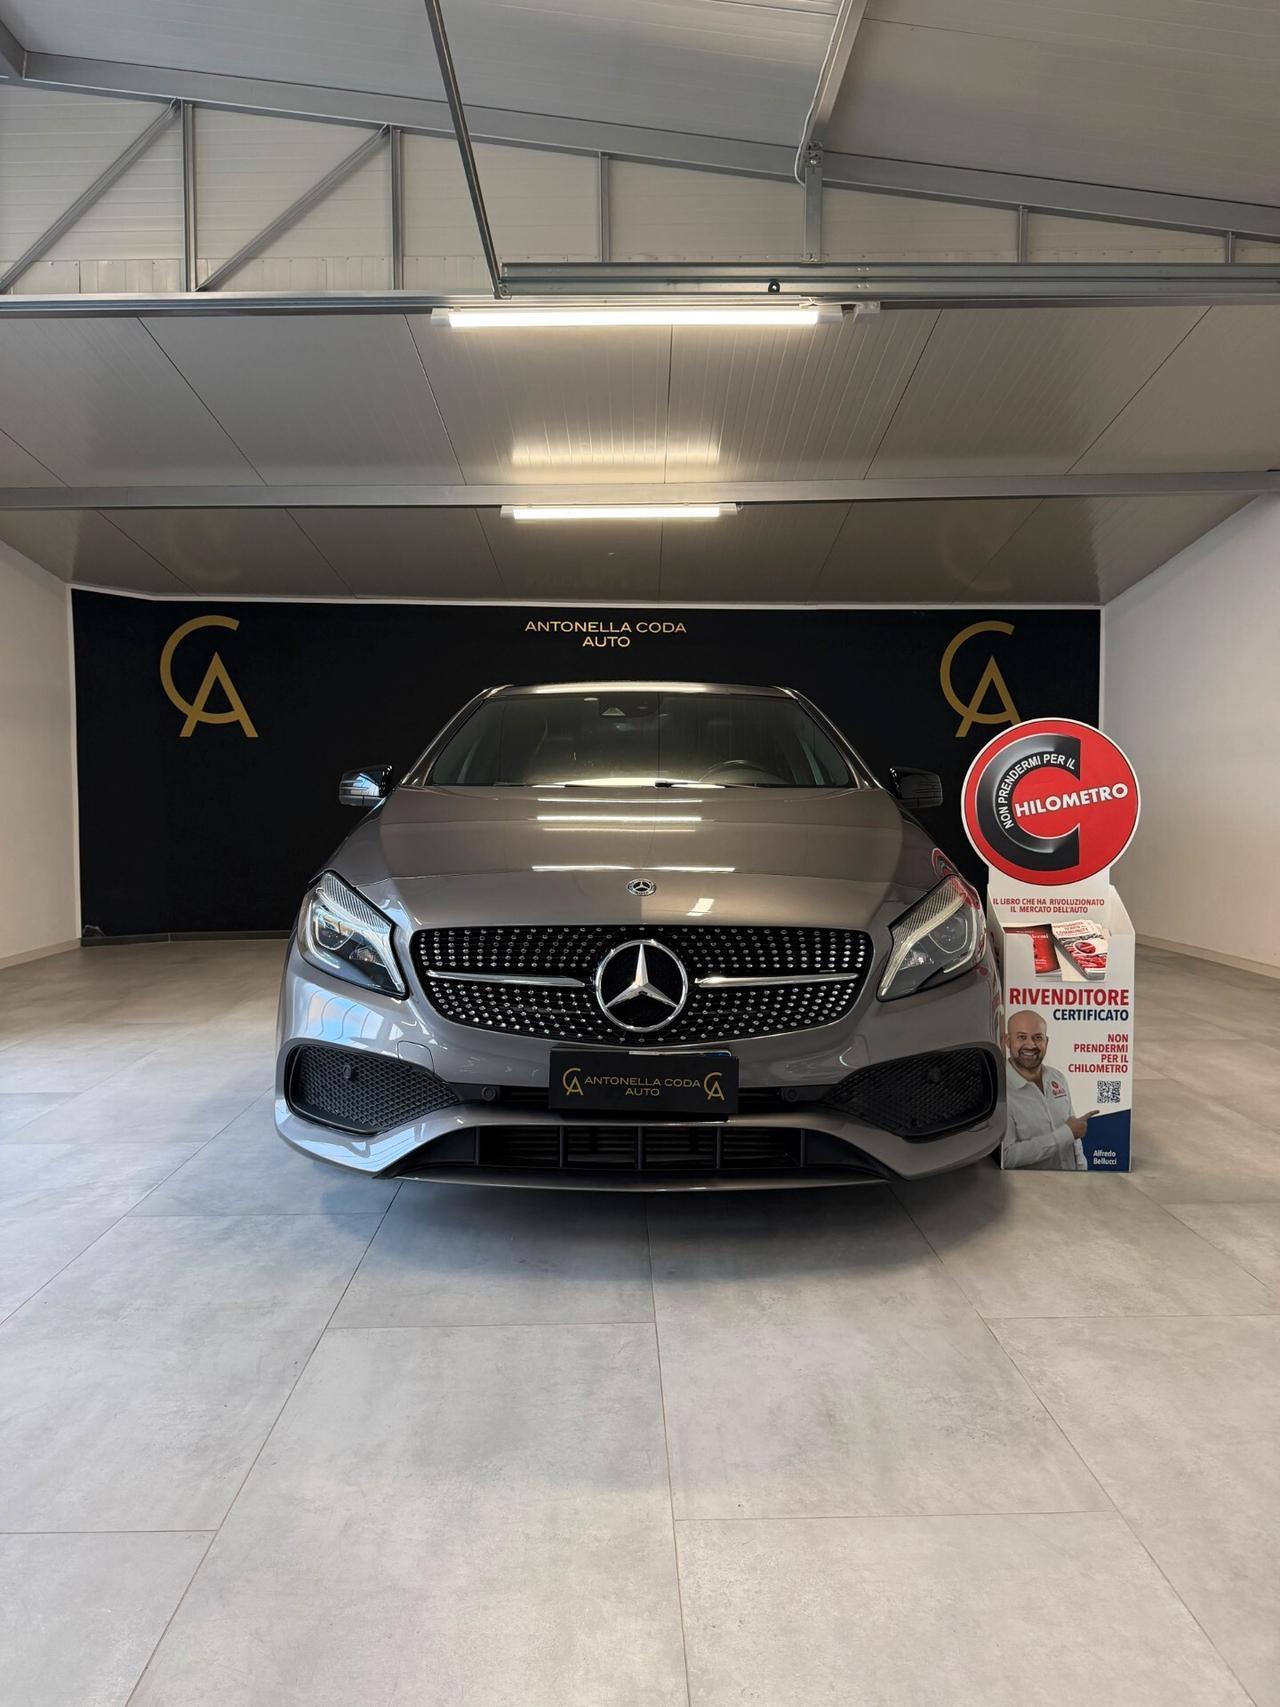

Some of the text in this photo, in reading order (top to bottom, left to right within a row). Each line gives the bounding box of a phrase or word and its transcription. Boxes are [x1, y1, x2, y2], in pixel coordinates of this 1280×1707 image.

[525, 621, 687, 633] ANTONELLA CODA
[582, 636, 631, 647] AUTO
[998, 754, 1075, 829] NON PRENDERMI PER IL
[1009, 988, 1129, 1006] RIVENDITORE
[1053, 1009, 1129, 1021] CERTIFICATO
[1108, 1034, 1129, 1043] NON
[1074, 1044, 1128, 1053] PRENDERMI
[1101, 1054, 1129, 1063] PER IL
[1068, 1064, 1128, 1073] CHILOMETRO
[584, 1076, 661, 1086] ANTONELLA
[664, 1078, 700, 1088] CODA
[625, 1088, 660, 1096] AUTO
